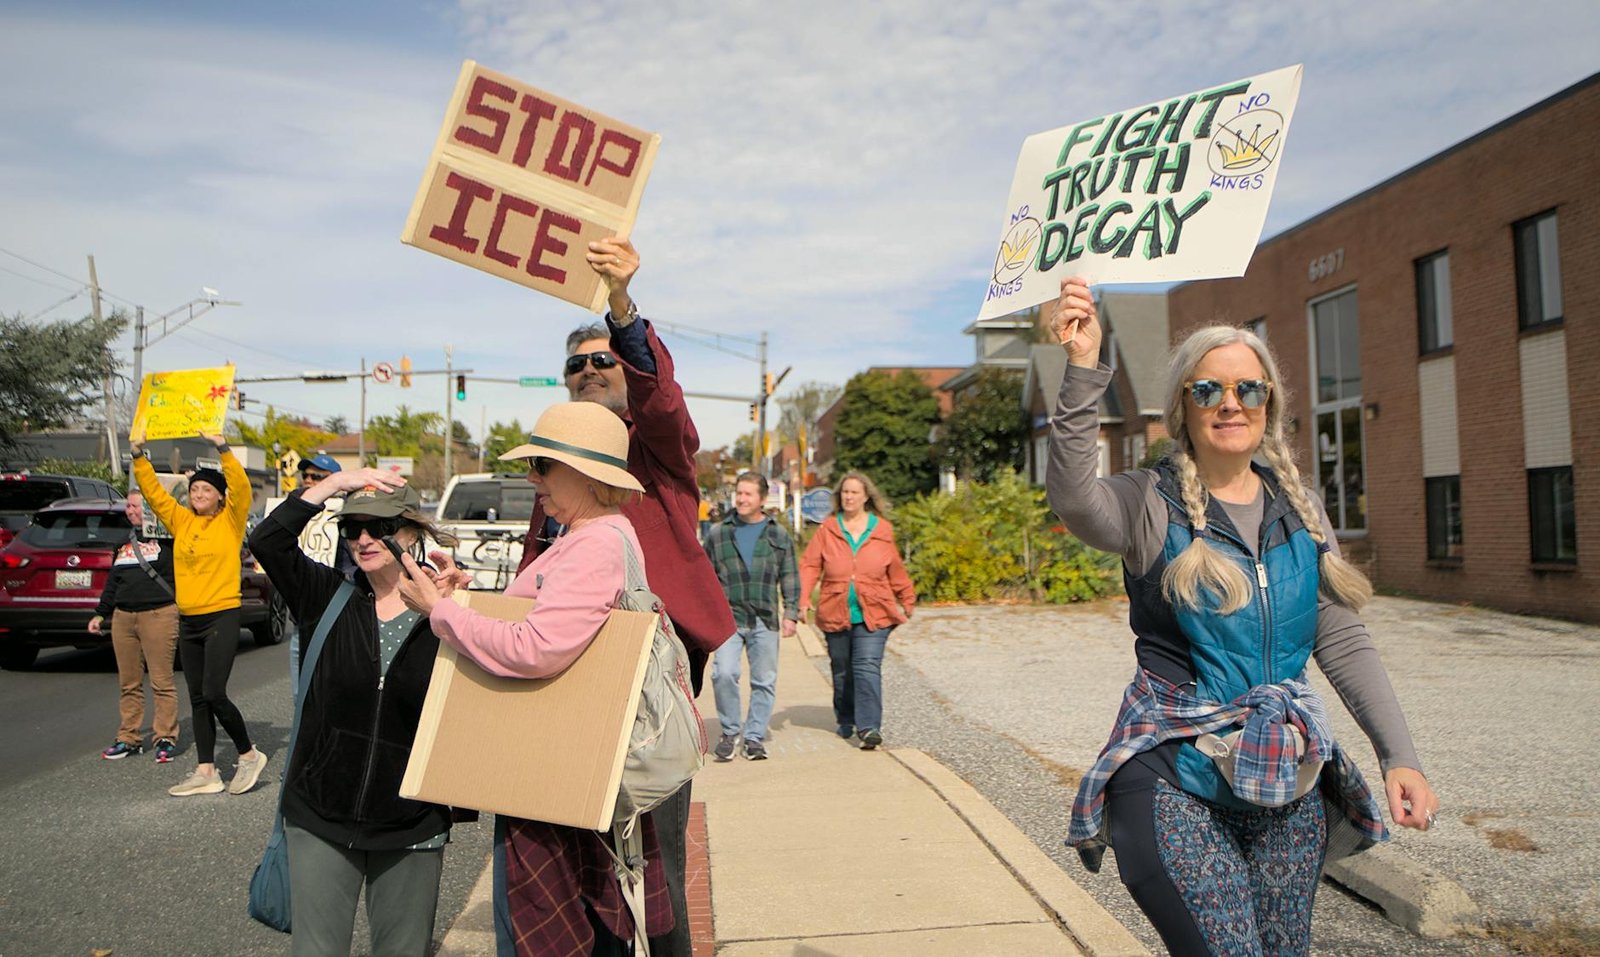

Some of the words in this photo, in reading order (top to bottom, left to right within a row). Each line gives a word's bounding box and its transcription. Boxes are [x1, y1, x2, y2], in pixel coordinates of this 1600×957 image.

[454, 76, 642, 186] STOP
[1057, 80, 1251, 168] FIGHT
[1239, 92, 1271, 113] NO
[1010, 204, 1029, 225] NO
[1042, 142, 1191, 221] TRUTH
[1210, 174, 1264, 190] KINGS
[429, 172, 581, 284] ICE
[1034, 191, 1212, 273] DECAY
[987, 279, 1024, 302] KINGS
